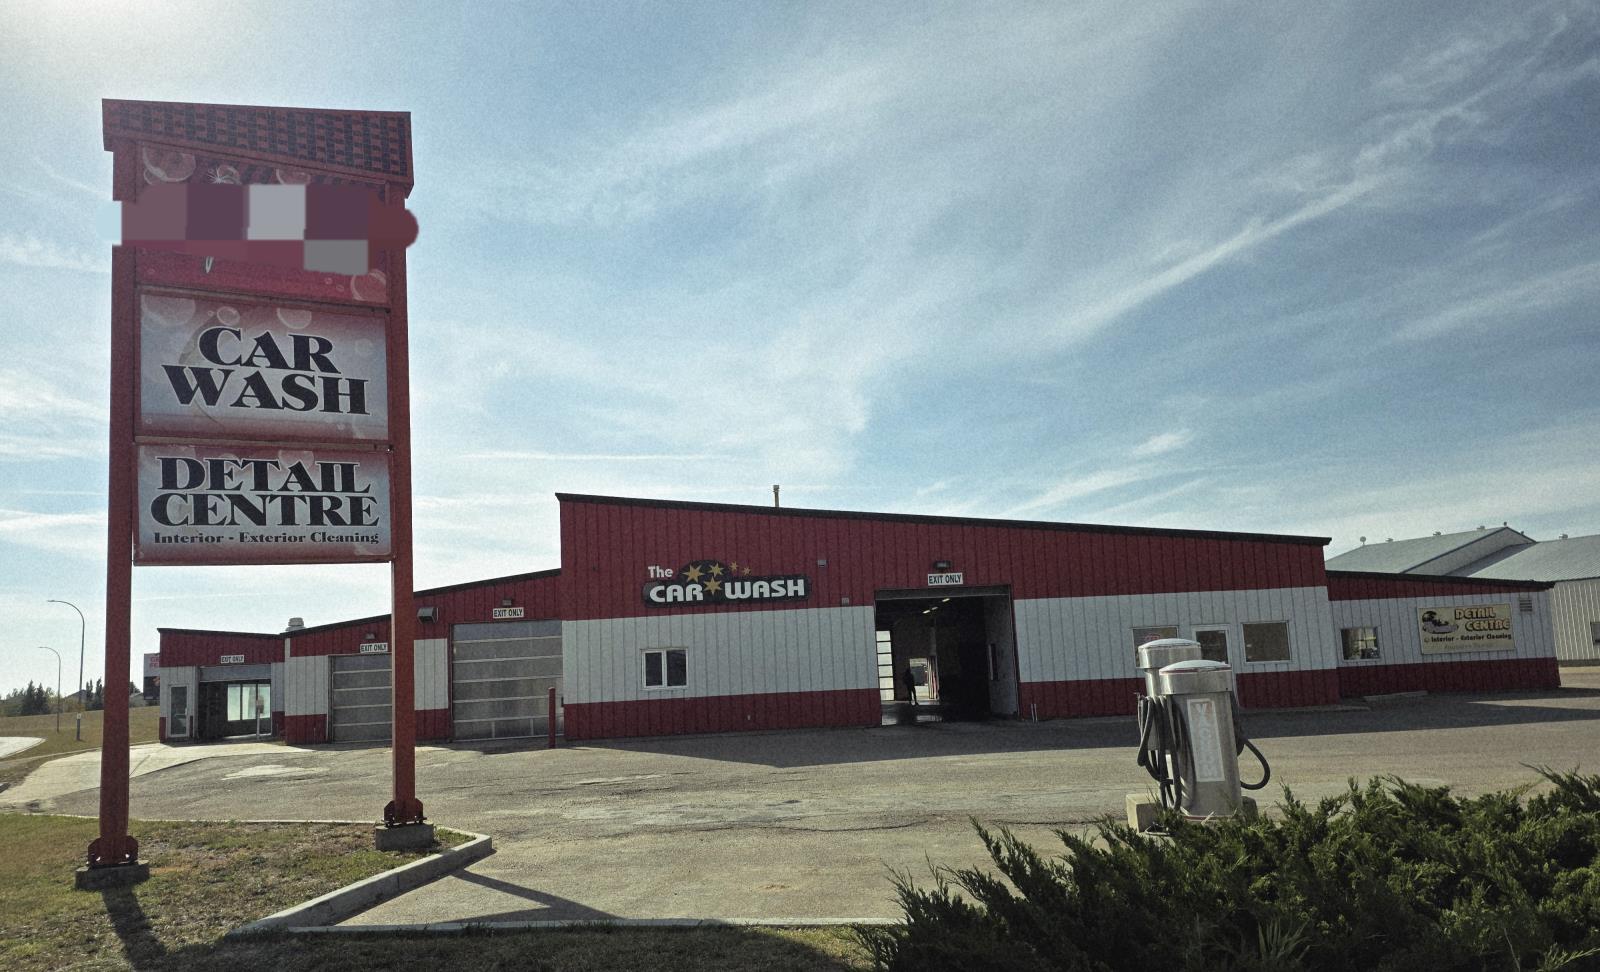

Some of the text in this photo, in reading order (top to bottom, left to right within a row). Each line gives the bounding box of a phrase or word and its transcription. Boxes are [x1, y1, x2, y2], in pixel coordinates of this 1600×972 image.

[198, 326, 342, 375] CAR
[161, 364, 371, 416] WASH
[156, 457, 371, 494] DETAIL
[150, 492, 379, 527] CENTRE
[154, 532, 224, 544] Interior
[239, 531, 306, 544] Exterior
[310, 531, 380, 545] Cleaning
[648, 565, 674, 579] The
[928, 574, 962, 585] EXIT ONLY
[650, 578, 805, 603] CAR WASH
[493, 608, 523, 618] EXIT ONLY
[1454, 606, 1497, 620] DETAIL
[1464, 618, 1511, 632] CENTRE
[360, 644, 373, 652] EXIT
